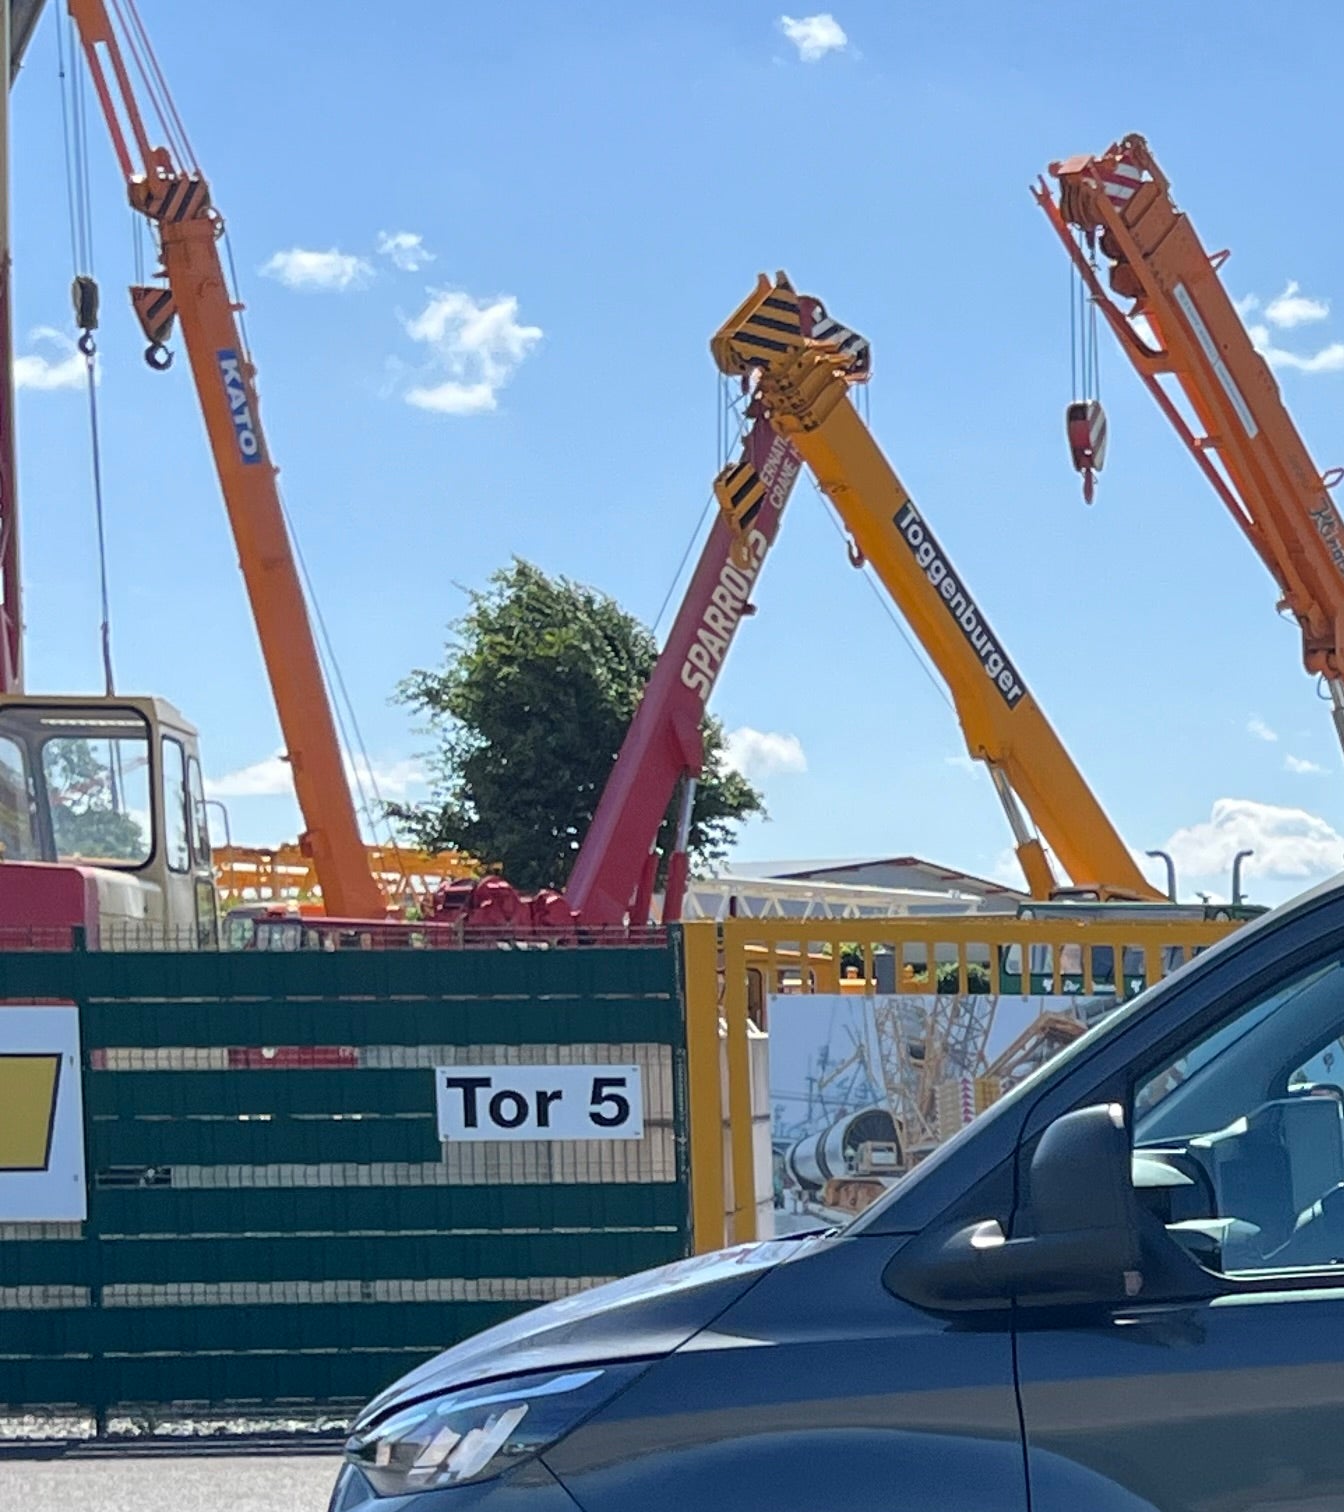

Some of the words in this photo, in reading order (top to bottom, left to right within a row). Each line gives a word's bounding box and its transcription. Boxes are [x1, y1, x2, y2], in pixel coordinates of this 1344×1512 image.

[220, 358, 258, 456] KATO
[769, 457, 798, 509] CRANE
[680, 528, 768, 700] SPARROS
[899, 502, 1023, 701] Toggenburger
[446, 1076, 563, 1129] Tor
[588, 1076, 631, 1128] 5
